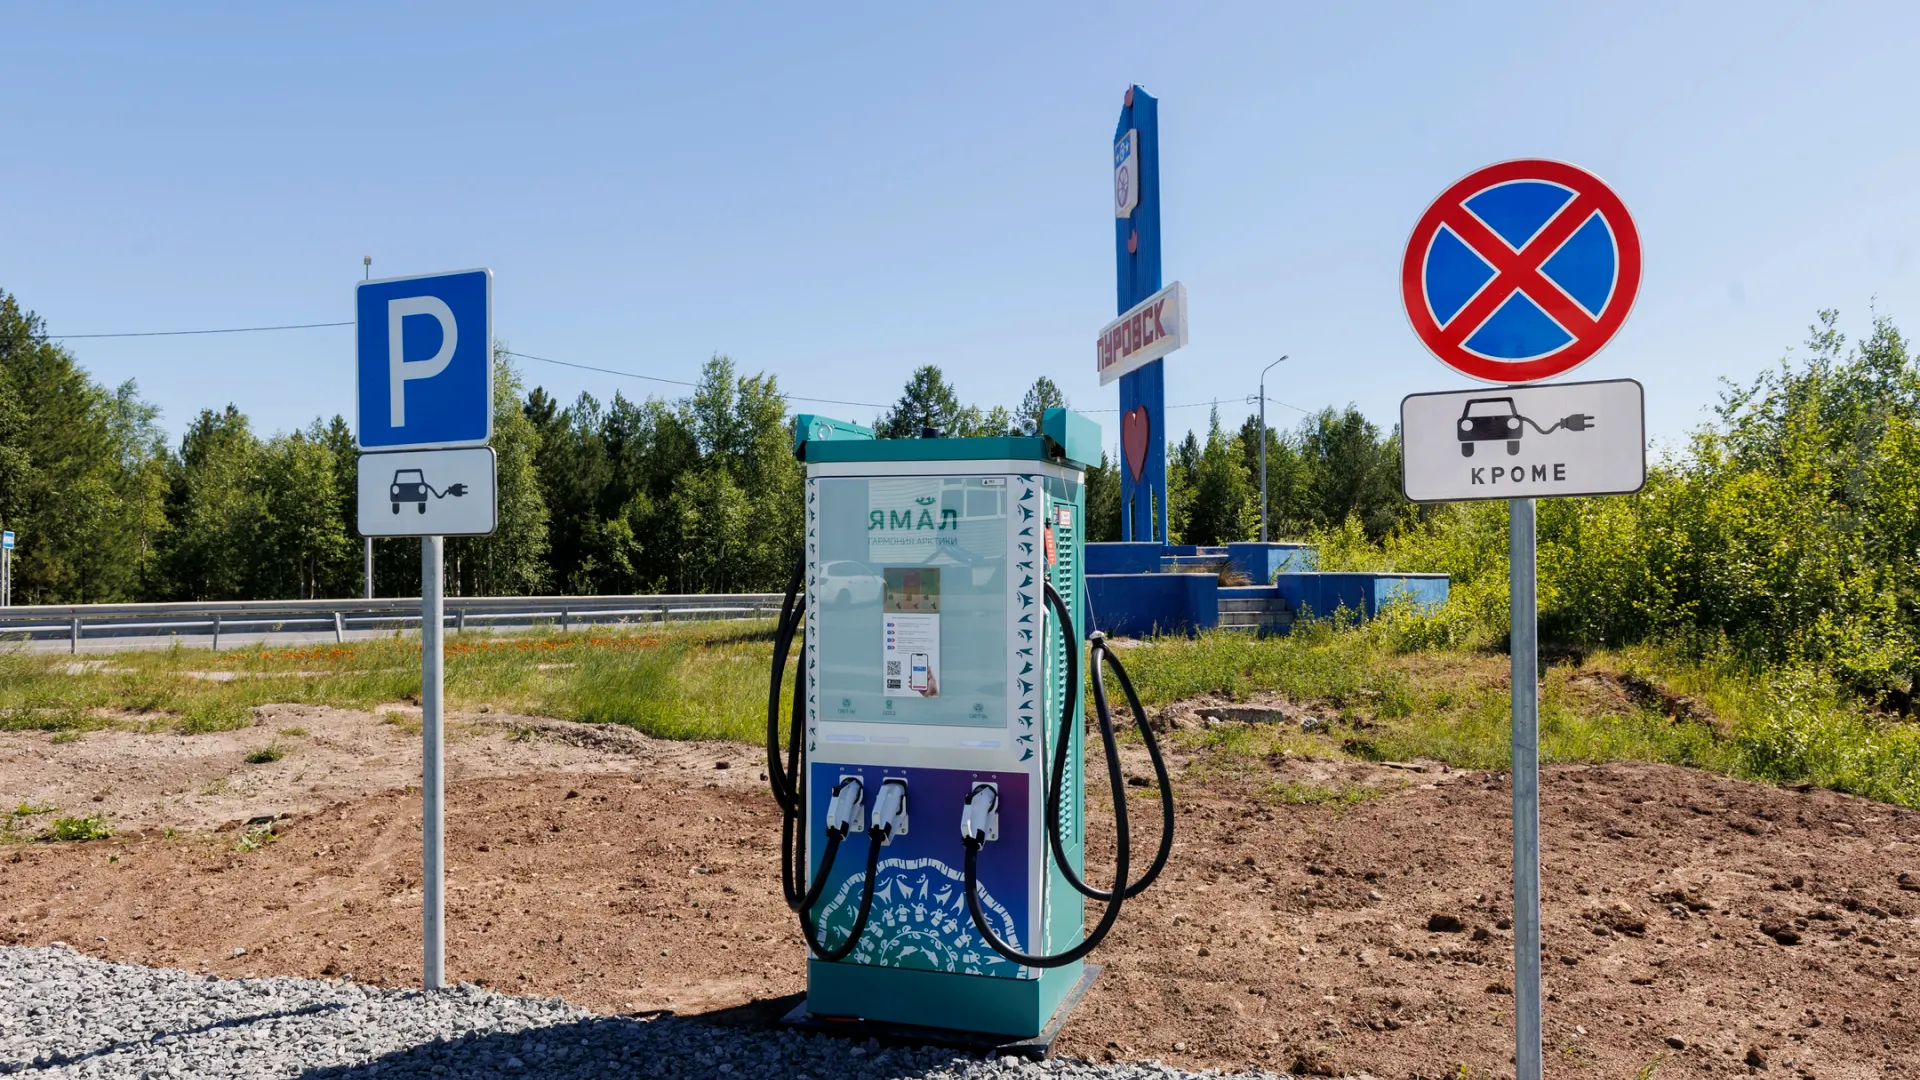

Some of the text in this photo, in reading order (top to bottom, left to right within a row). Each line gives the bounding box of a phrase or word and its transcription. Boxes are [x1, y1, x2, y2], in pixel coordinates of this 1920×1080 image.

[1097, 298, 1166, 372] ПУРОВСК
[388, 295, 458, 428] P
[1471, 463, 1566, 485] КРОМЕ
[867, 508, 958, 531] ЯМАЛ
[867, 537, 958, 546] ГАРМОНИЯ АРКТИКИ
